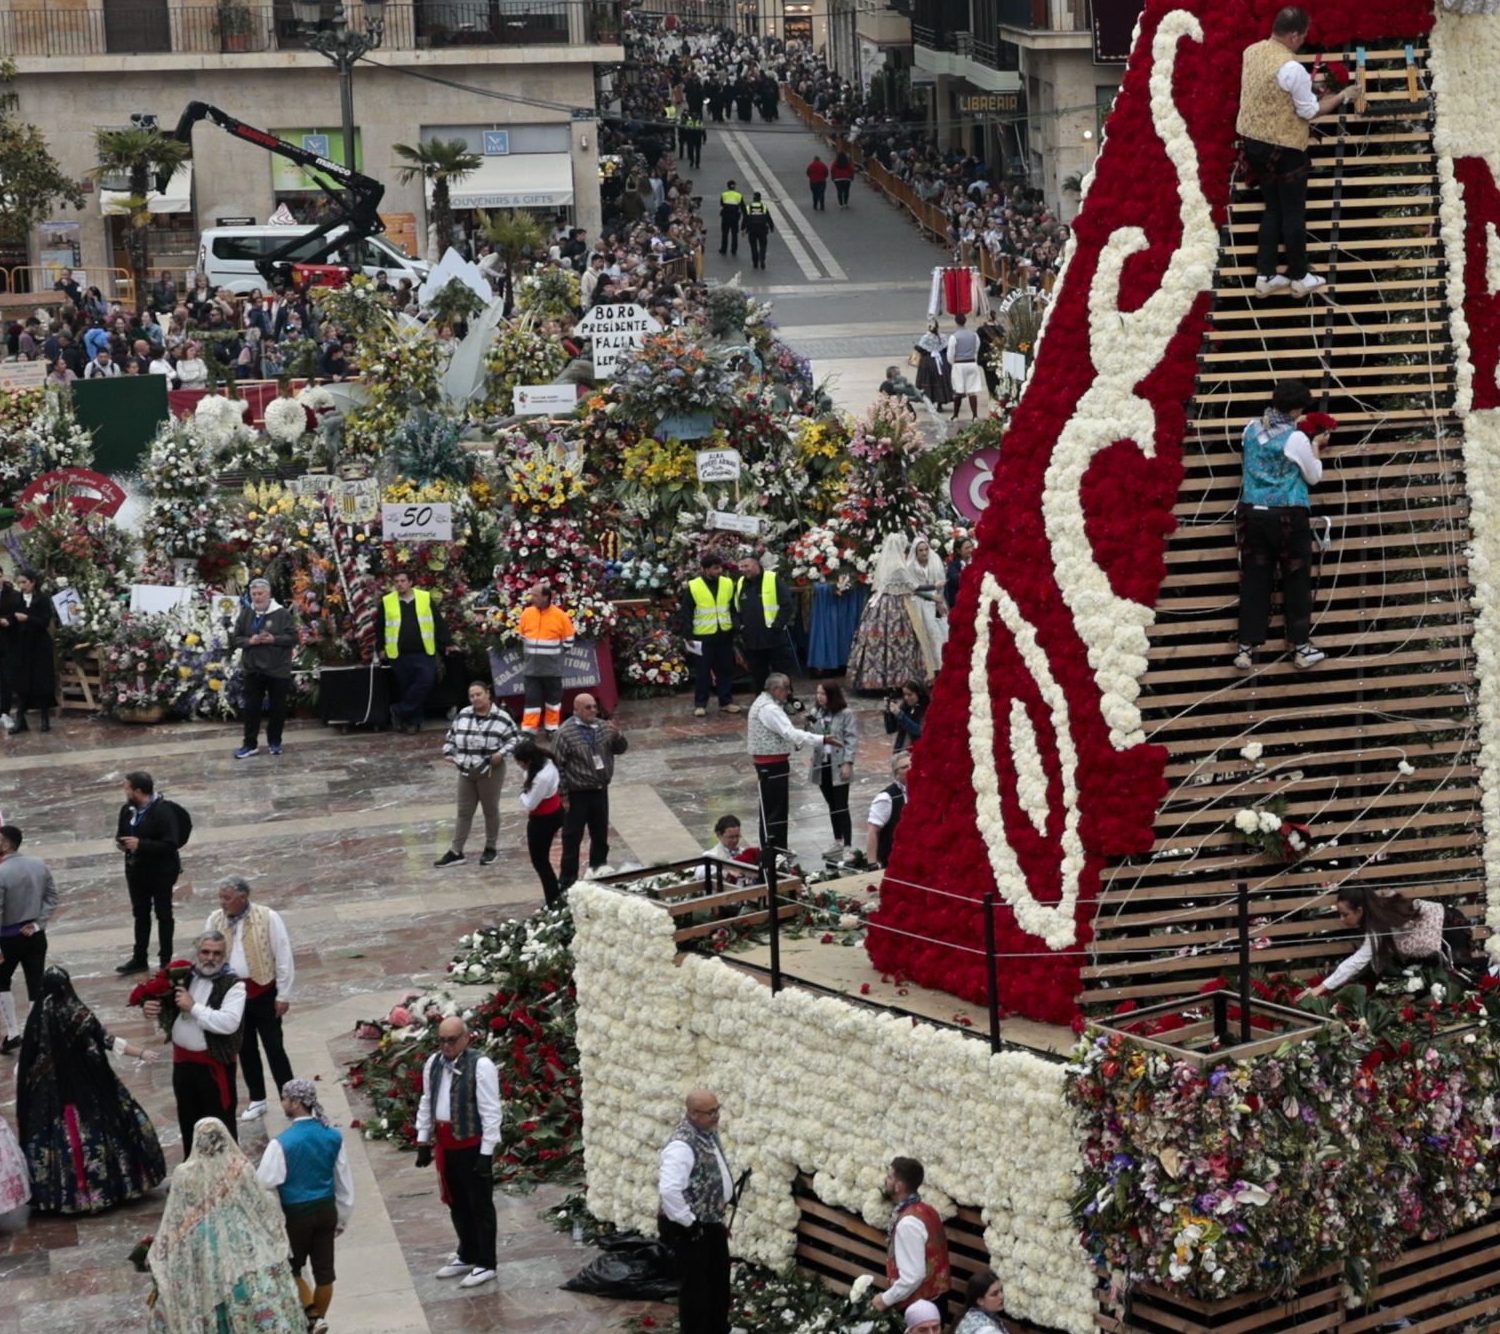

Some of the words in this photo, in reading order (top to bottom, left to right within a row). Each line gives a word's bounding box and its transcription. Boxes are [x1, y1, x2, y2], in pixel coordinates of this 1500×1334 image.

[315, 157, 351, 176] mateco
[523, 195, 554, 204] GIFTS
[581, 320, 648, 333] PRESIDENTE
[400, 506, 433, 527] 50
